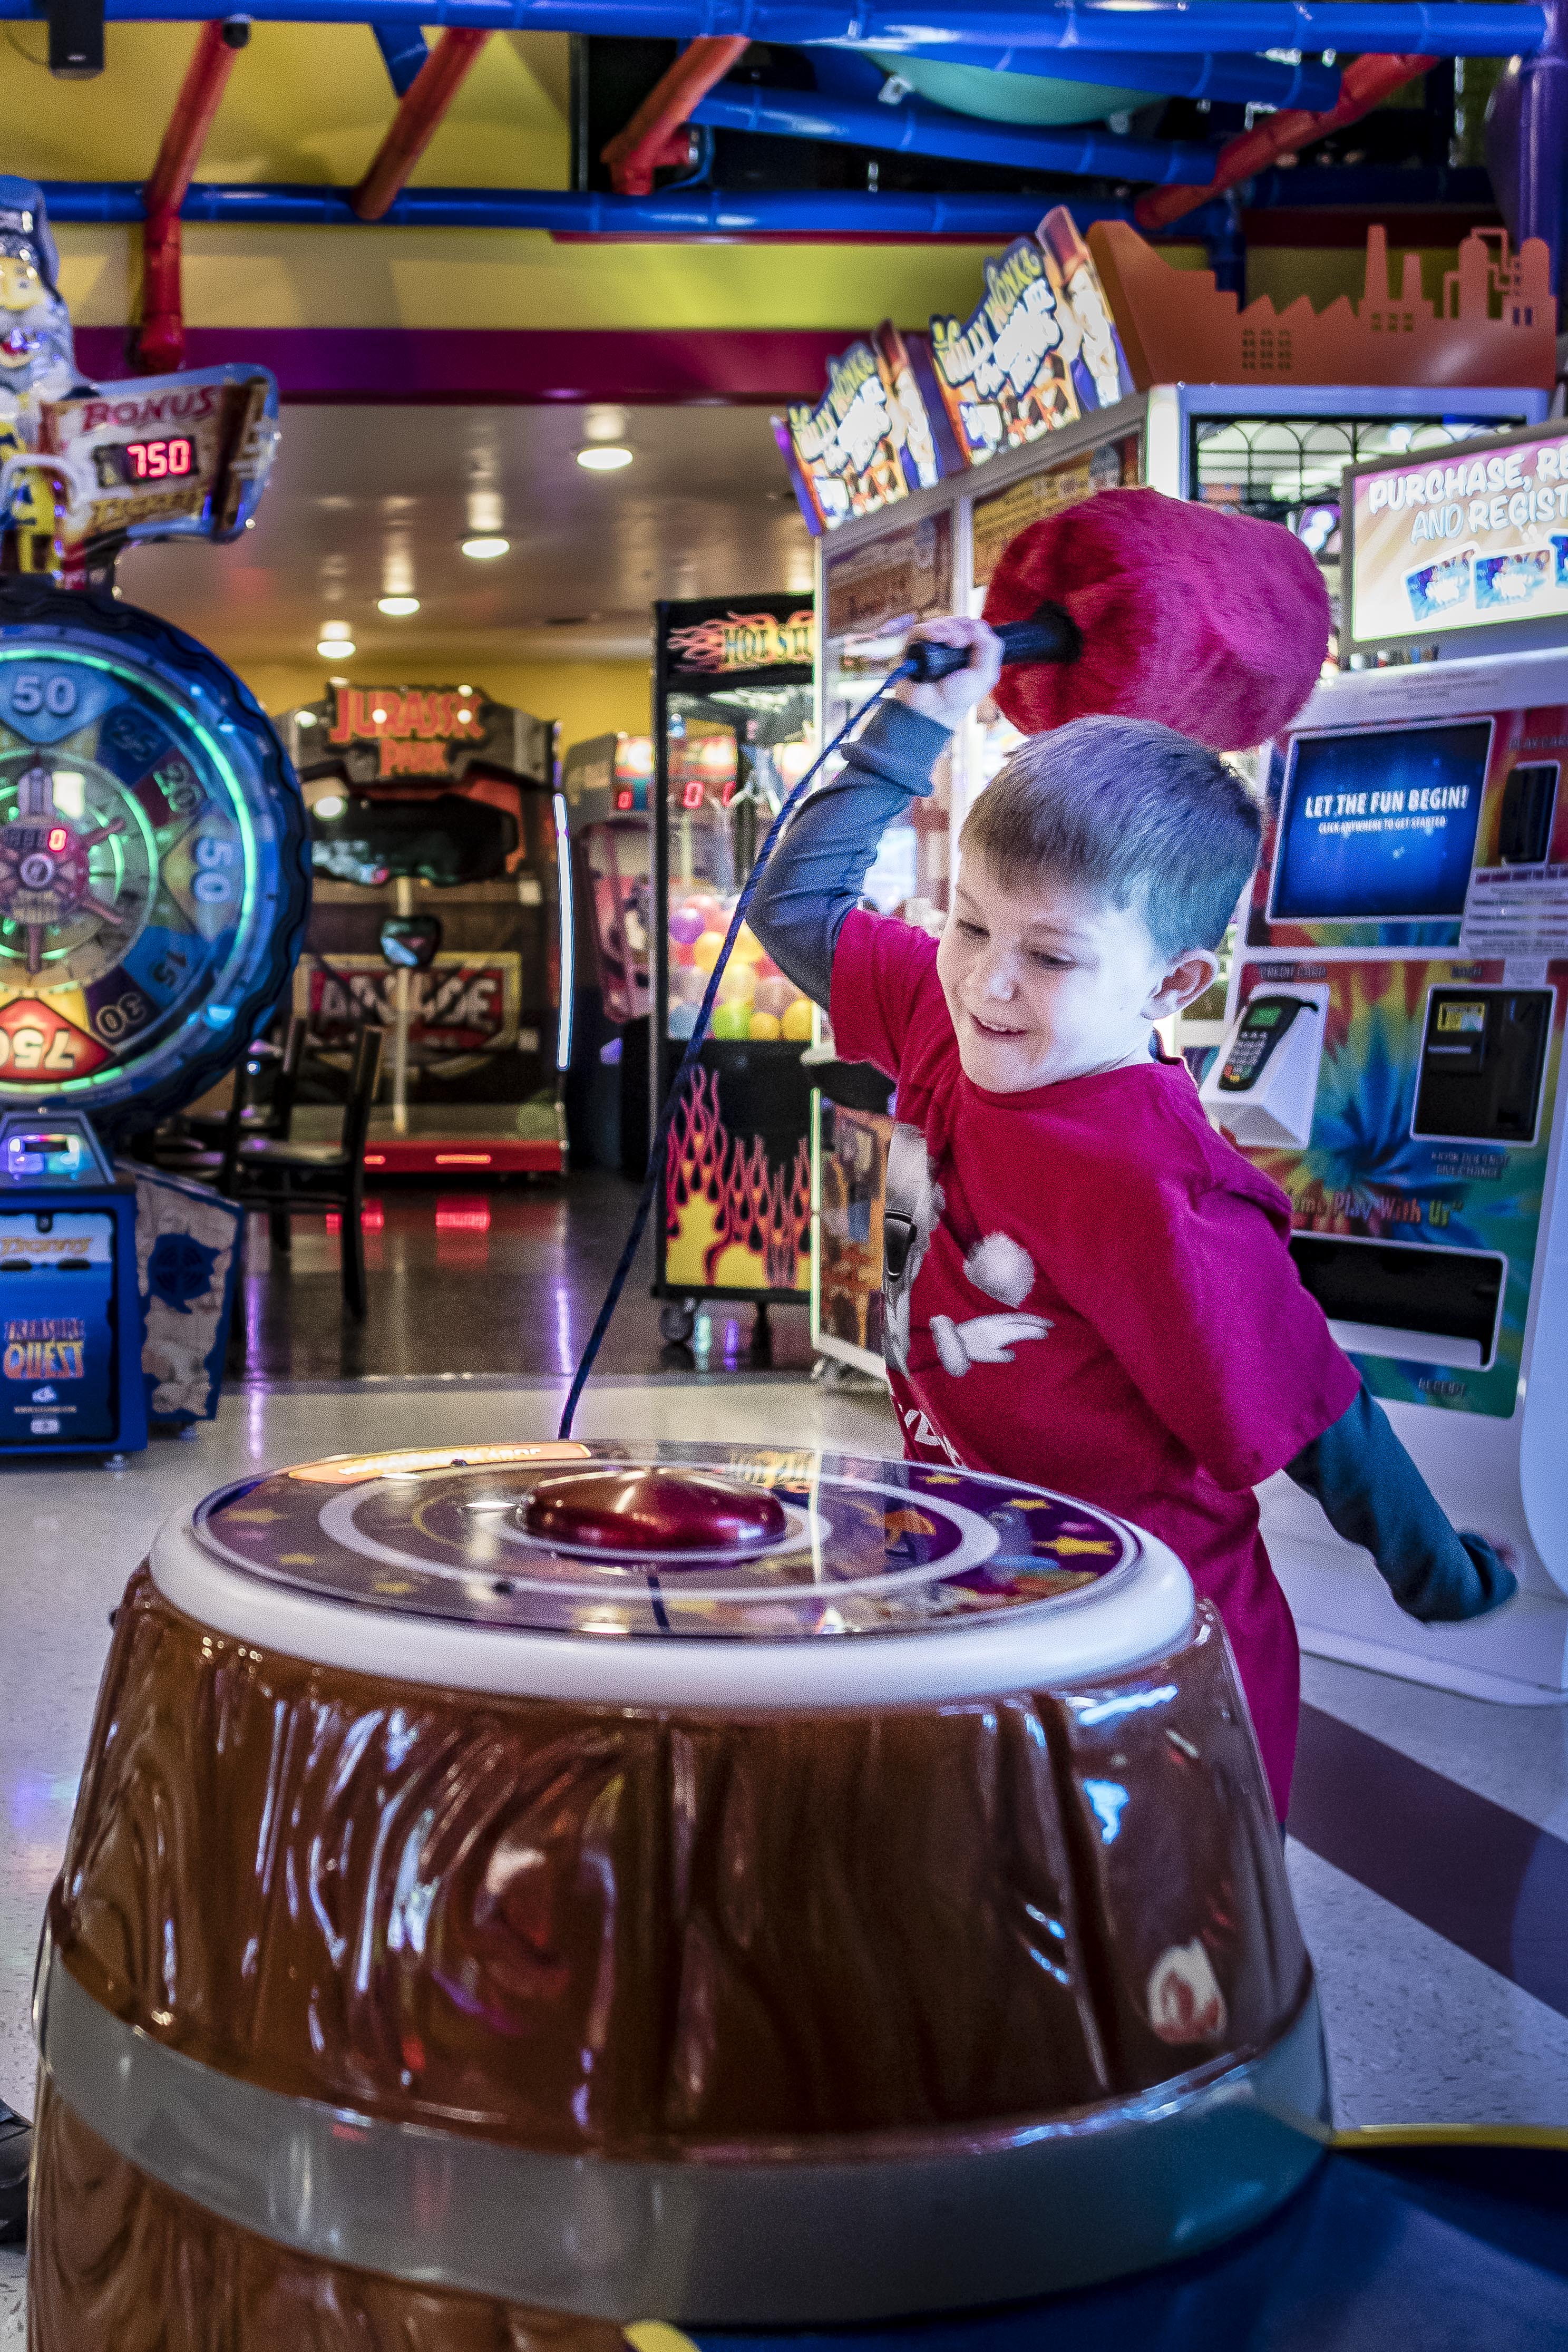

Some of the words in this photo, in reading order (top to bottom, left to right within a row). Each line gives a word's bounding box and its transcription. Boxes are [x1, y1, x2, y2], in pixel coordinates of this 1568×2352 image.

[81, 386, 216, 433] BONUS
[126, 439, 191, 478] 750
[1370, 452, 1532, 514] PURCHASE,
[1536, 444, 1568, 482] RE
[1410, 503, 1464, 545] AND
[1468, 483, 1568, 533] REGIST
[723, 626, 766, 664] HOT
[12, 676, 77, 714] 50
[329, 687, 485, 743] JURASSIC
[379, 738, 449, 776] PARK
[1541, 734, 1568, 748] CAR
[1304, 795, 1333, 818] LET
[1336, 792, 1367, 815] THE
[1370, 790, 1405, 814] FUN
[1408, 785, 1469, 811] BEGIN!
[193, 837, 233, 903] 50
[95, 990, 147, 1036] 30
[1334, 1191, 1374, 1222] Play
[1379, 1194, 1421, 1223] With
[4, 1340, 84, 1379] QUEST
